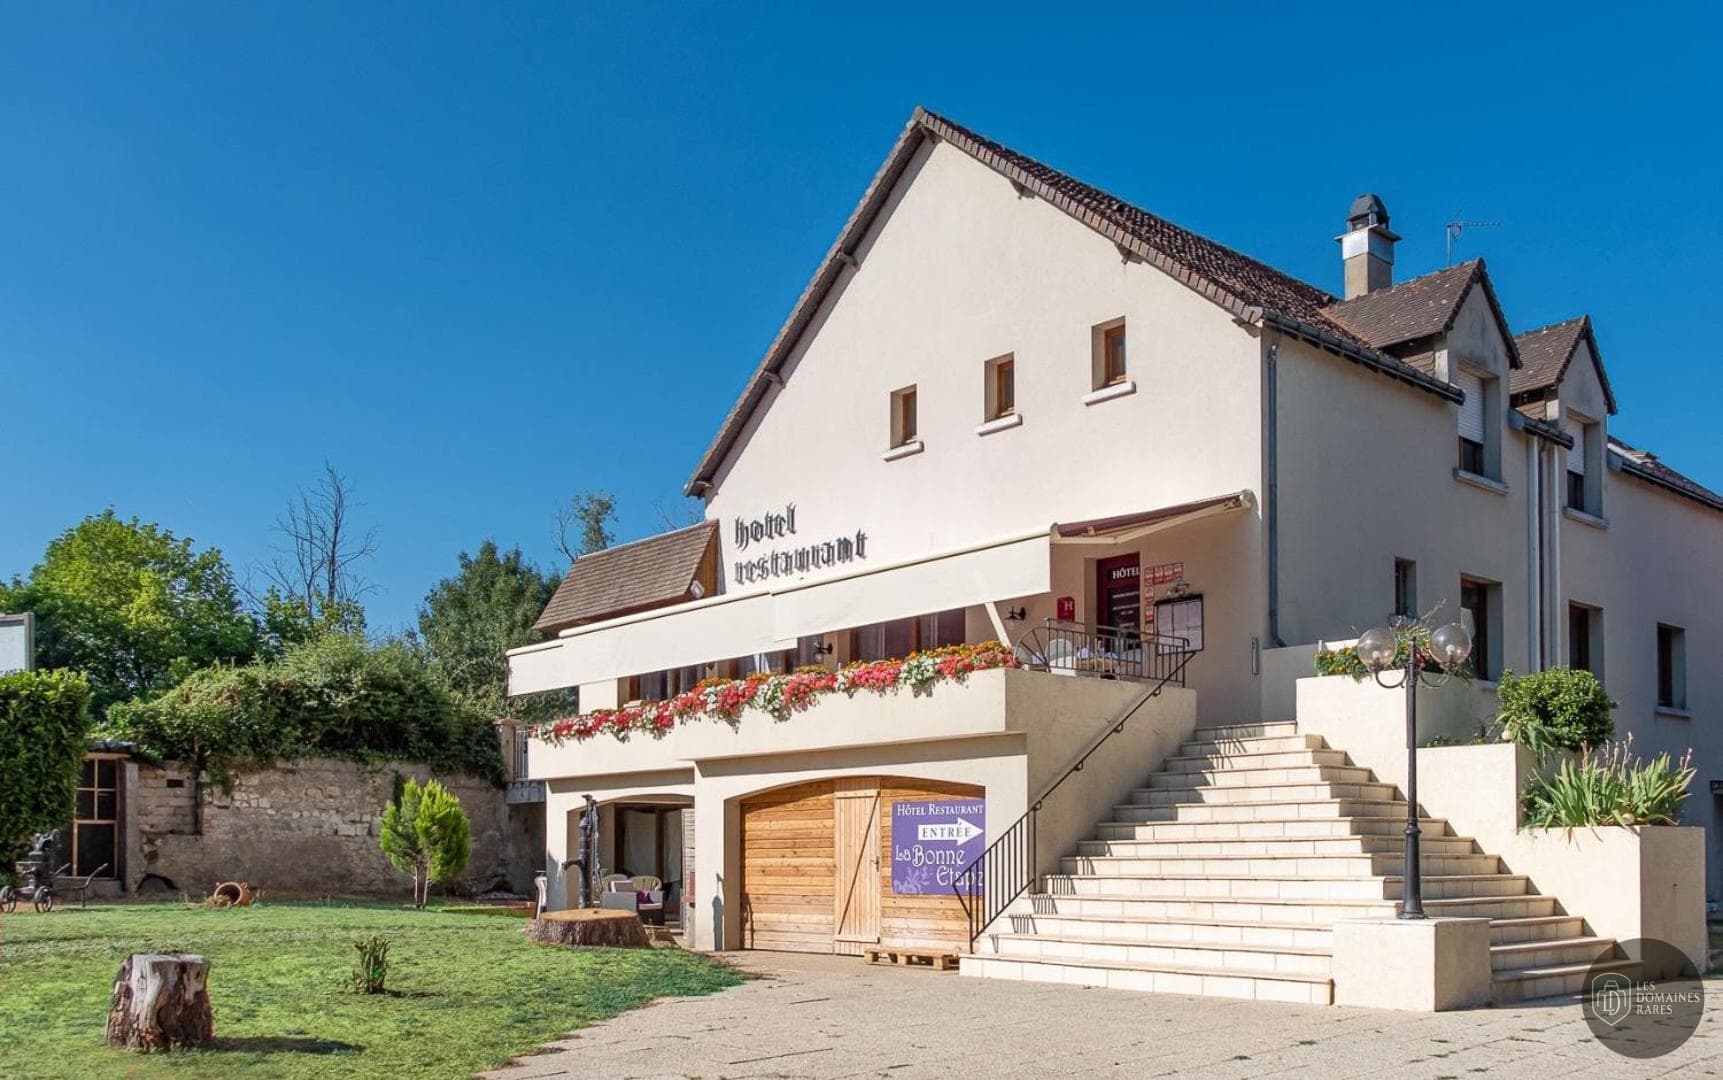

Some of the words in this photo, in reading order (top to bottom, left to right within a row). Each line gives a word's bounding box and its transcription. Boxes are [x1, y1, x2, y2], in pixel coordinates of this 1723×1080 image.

[735, 502, 797, 552] hotel
[734, 528, 868, 585] restaurant
[1112, 566, 1140, 579] HÔTEL
[897, 804, 926, 816] HÔTEL
[928, 803, 984, 816] RESTAURANT
[922, 822, 972, 838] ENTRÉE
[895, 844, 911, 861] La
[912, 844, 966, 867] Bonne
